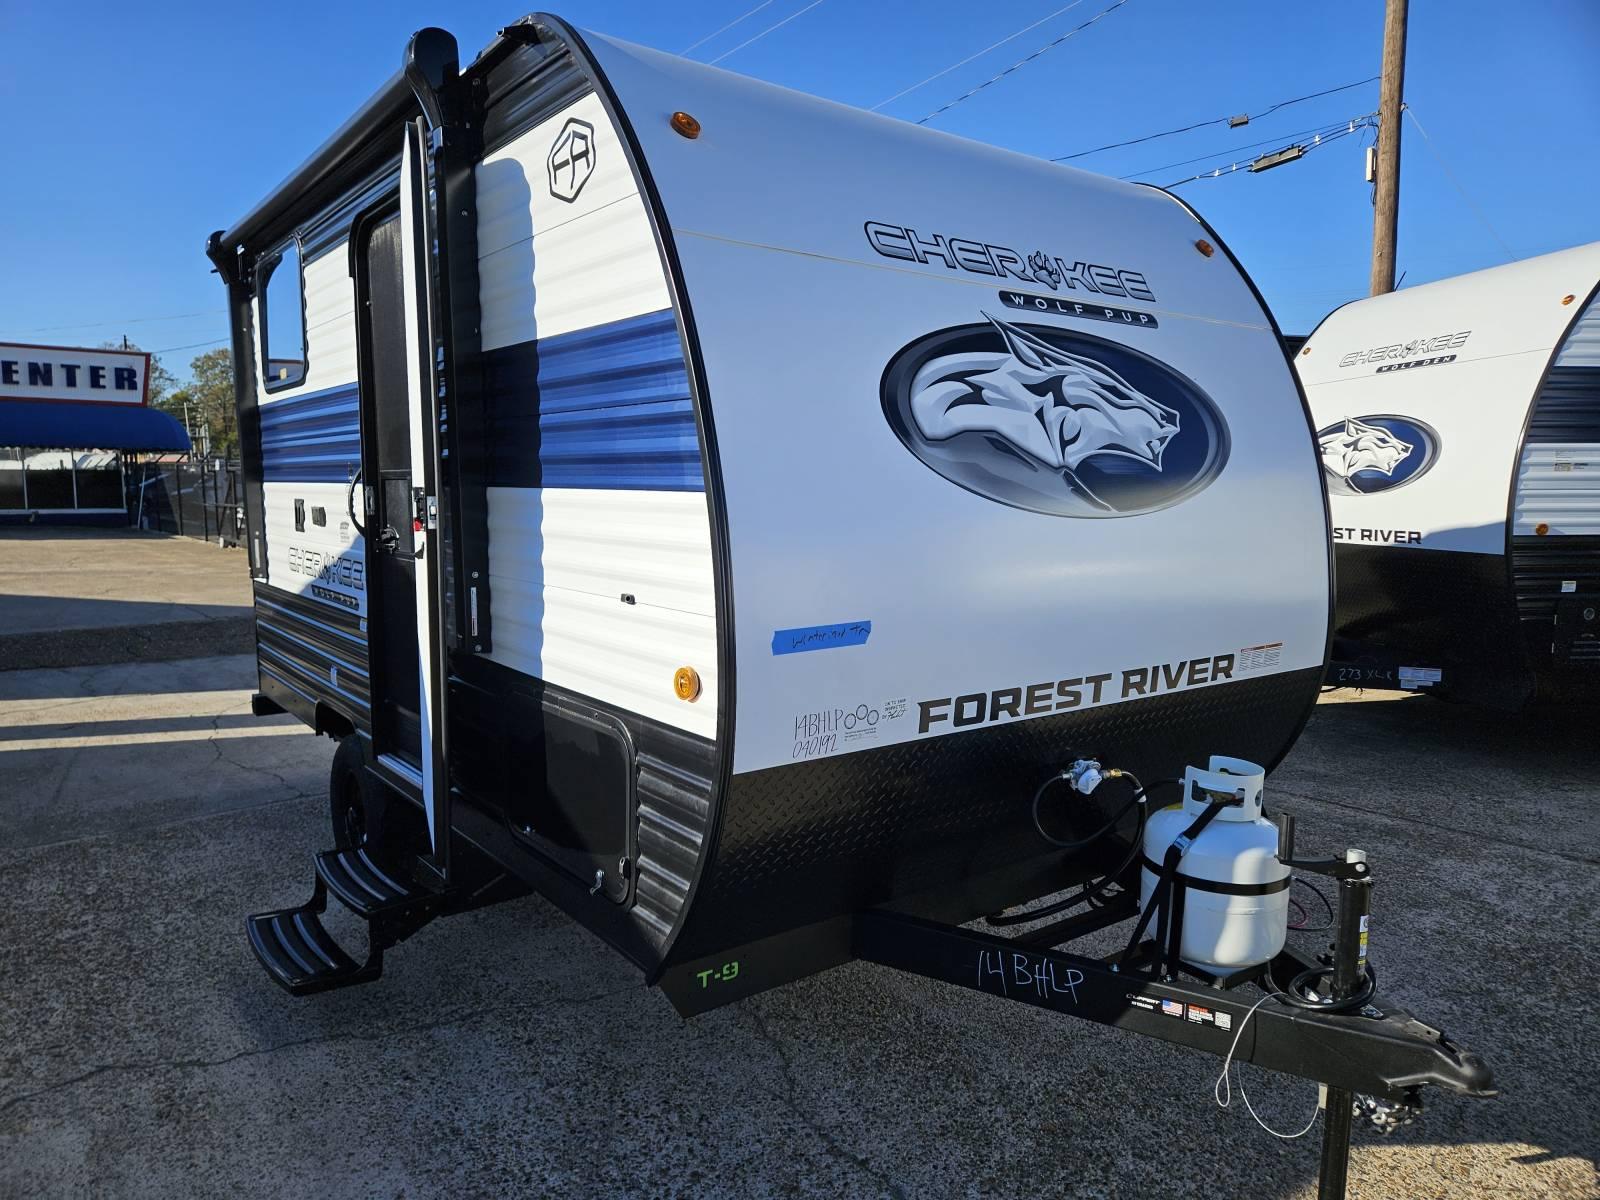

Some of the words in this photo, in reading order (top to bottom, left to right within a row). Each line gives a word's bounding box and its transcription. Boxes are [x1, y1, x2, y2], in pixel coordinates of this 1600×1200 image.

[1010, 294, 1083, 315] WOLF
[1105, 309, 1148, 325] PUP
[1, 360, 138, 390] ENTER
[1381, 361, 1417, 372] WOLF
[1423, 356, 1452, 367] DEN
[1360, 528, 1422, 545] RIVER
[917, 673, 1112, 734] FOREST
[1121, 653, 1235, 699] RIVER
[794, 709, 844, 740] 14BHLP
[696, 961, 739, 989] T-9
[978, 950, 1007, 996] 14
[1013, 953, 1084, 1004] BHLP
